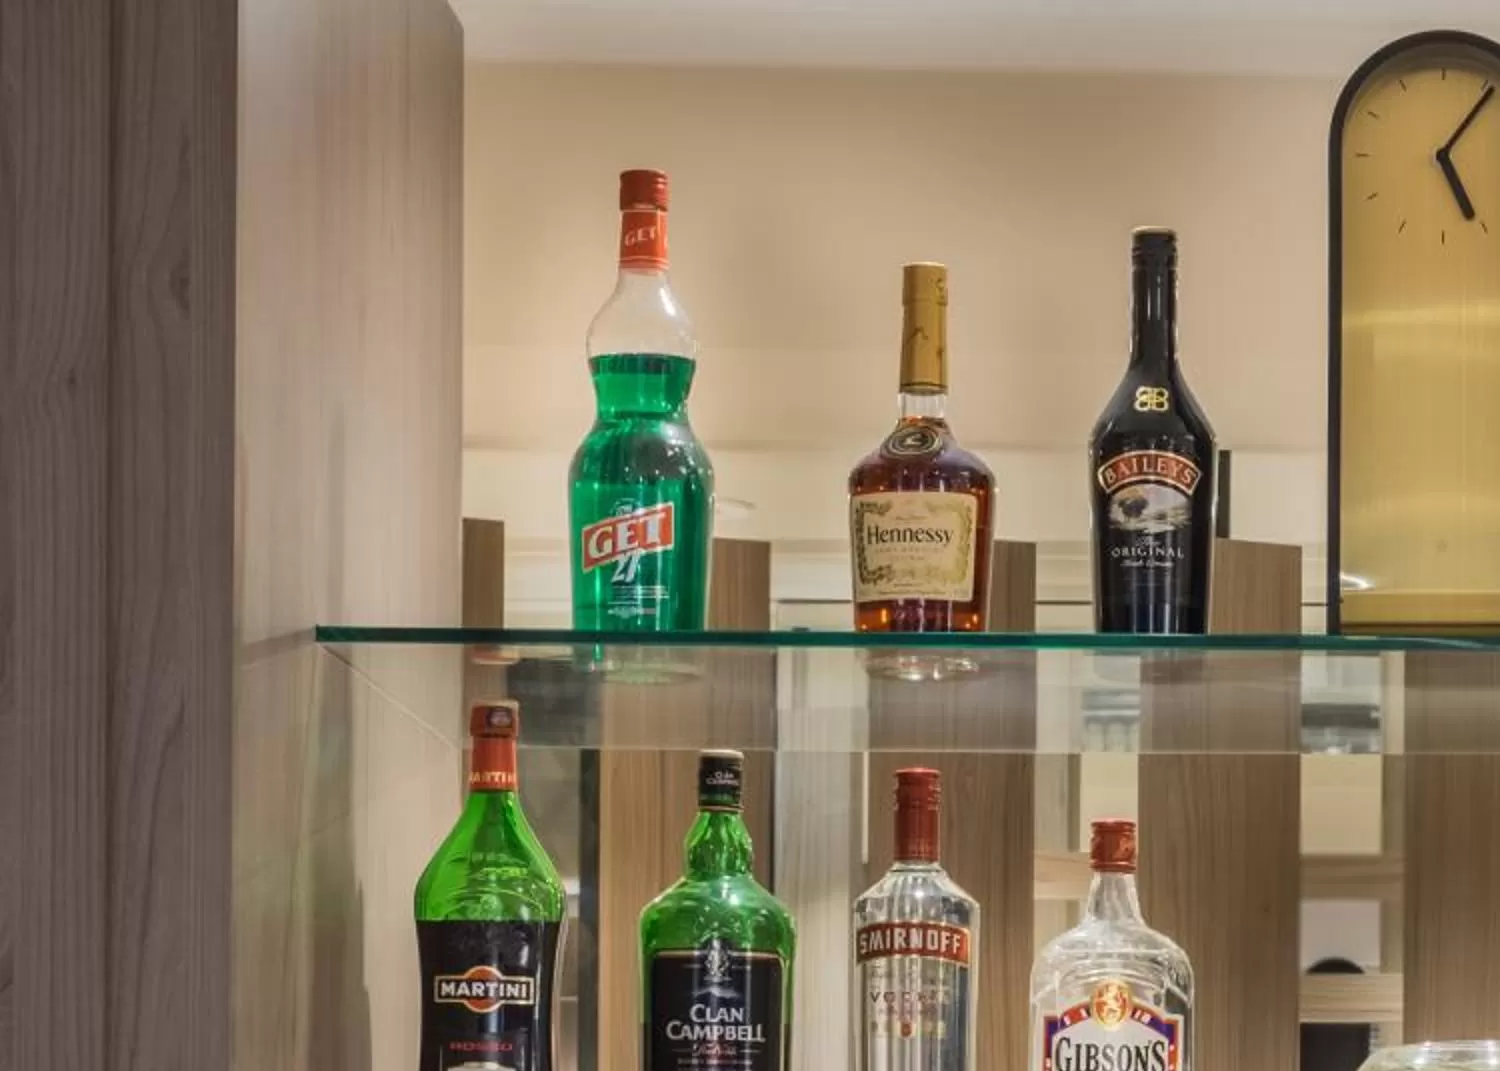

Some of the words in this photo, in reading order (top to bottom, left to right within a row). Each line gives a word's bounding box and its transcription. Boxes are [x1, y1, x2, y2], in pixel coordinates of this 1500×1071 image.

[624, 226, 657, 247] GET
[1104, 457, 1198, 485] BAILEYS
[588, 511, 667, 559] GET
[867, 525, 954, 547] Hennessy
[1111, 547, 1185, 559] ORIGINAL
[611, 550, 641, 583] 27
[860, 927, 961, 955] SMIRNOFF
[440, 981, 528, 999] MARTINI
